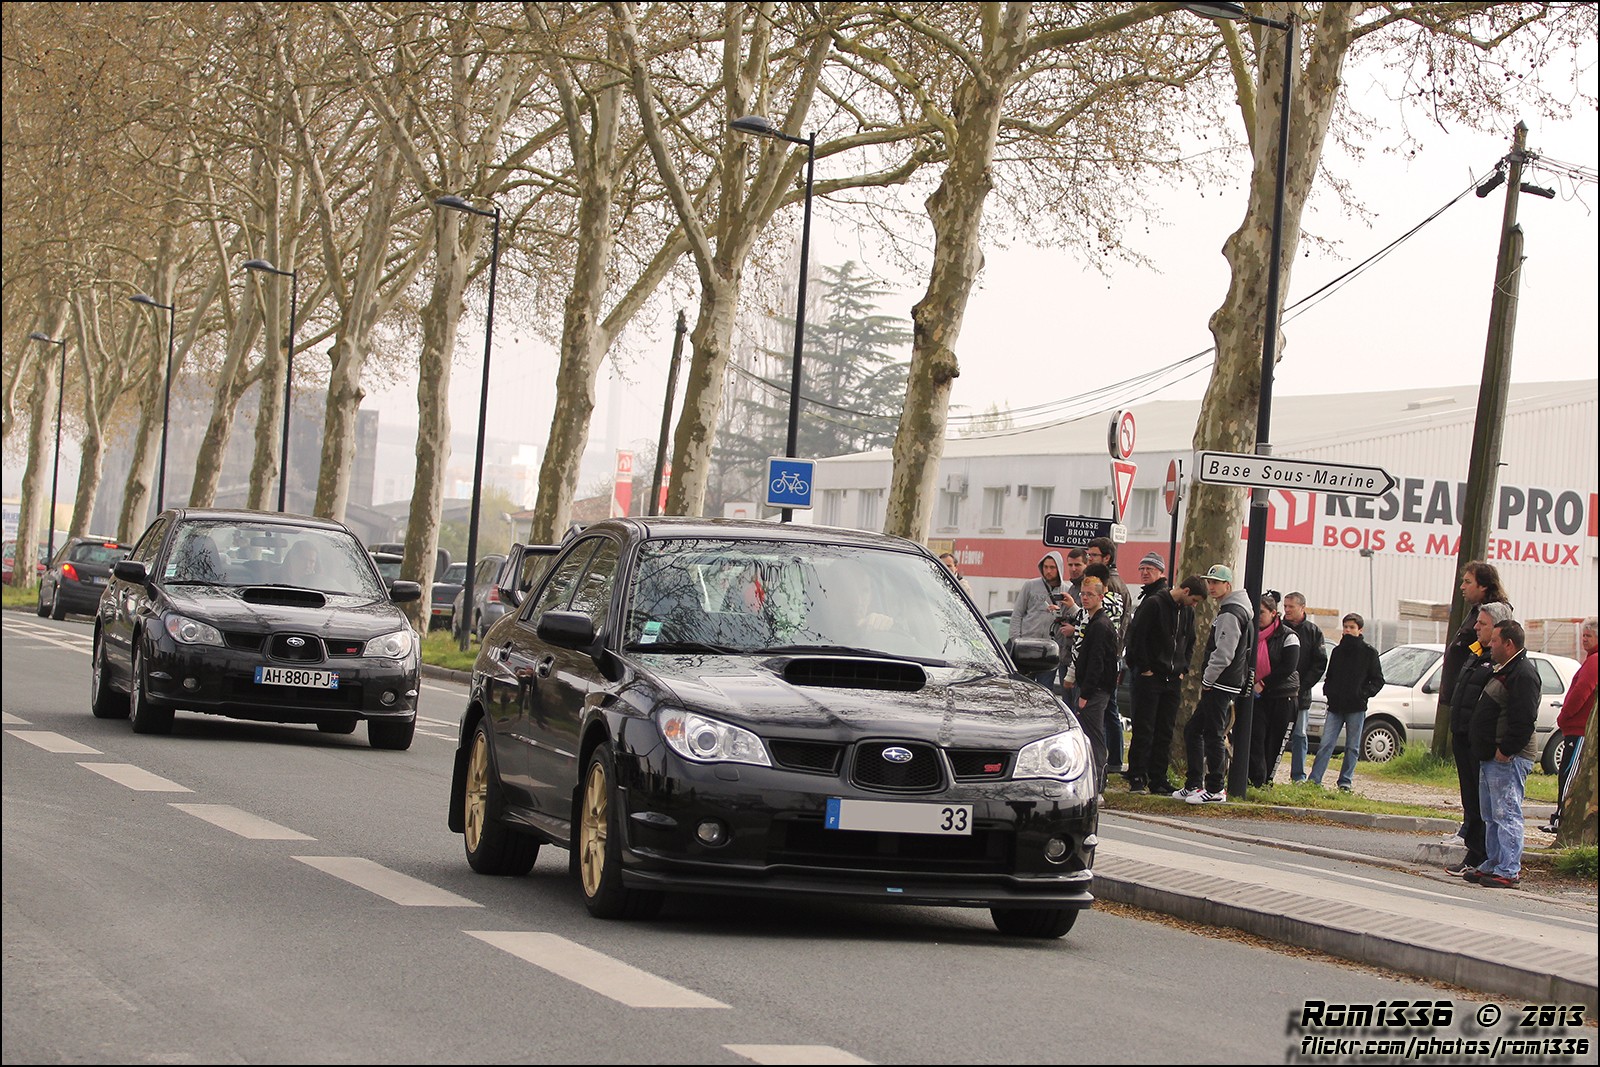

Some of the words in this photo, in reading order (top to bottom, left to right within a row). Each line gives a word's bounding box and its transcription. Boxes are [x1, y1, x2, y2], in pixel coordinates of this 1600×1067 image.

[1209, 460, 1251, 478] Base
[1261, 465, 1375, 489] Sous-Marine
[1498, 485, 1584, 536] PRO
[1065, 520, 1099, 530] IMPASSE
[1067, 528, 1096, 537] BROWN
[1054, 535, 1065, 543] DE
[1066, 537, 1094, 545] COLST
[1323, 525, 1386, 551] BOIS
[1395, 531, 1415, 553] &
[264, 668, 331, 687] AH-880-PJ
[829, 816, 835, 824] F
[940, 807, 968, 832] 33
